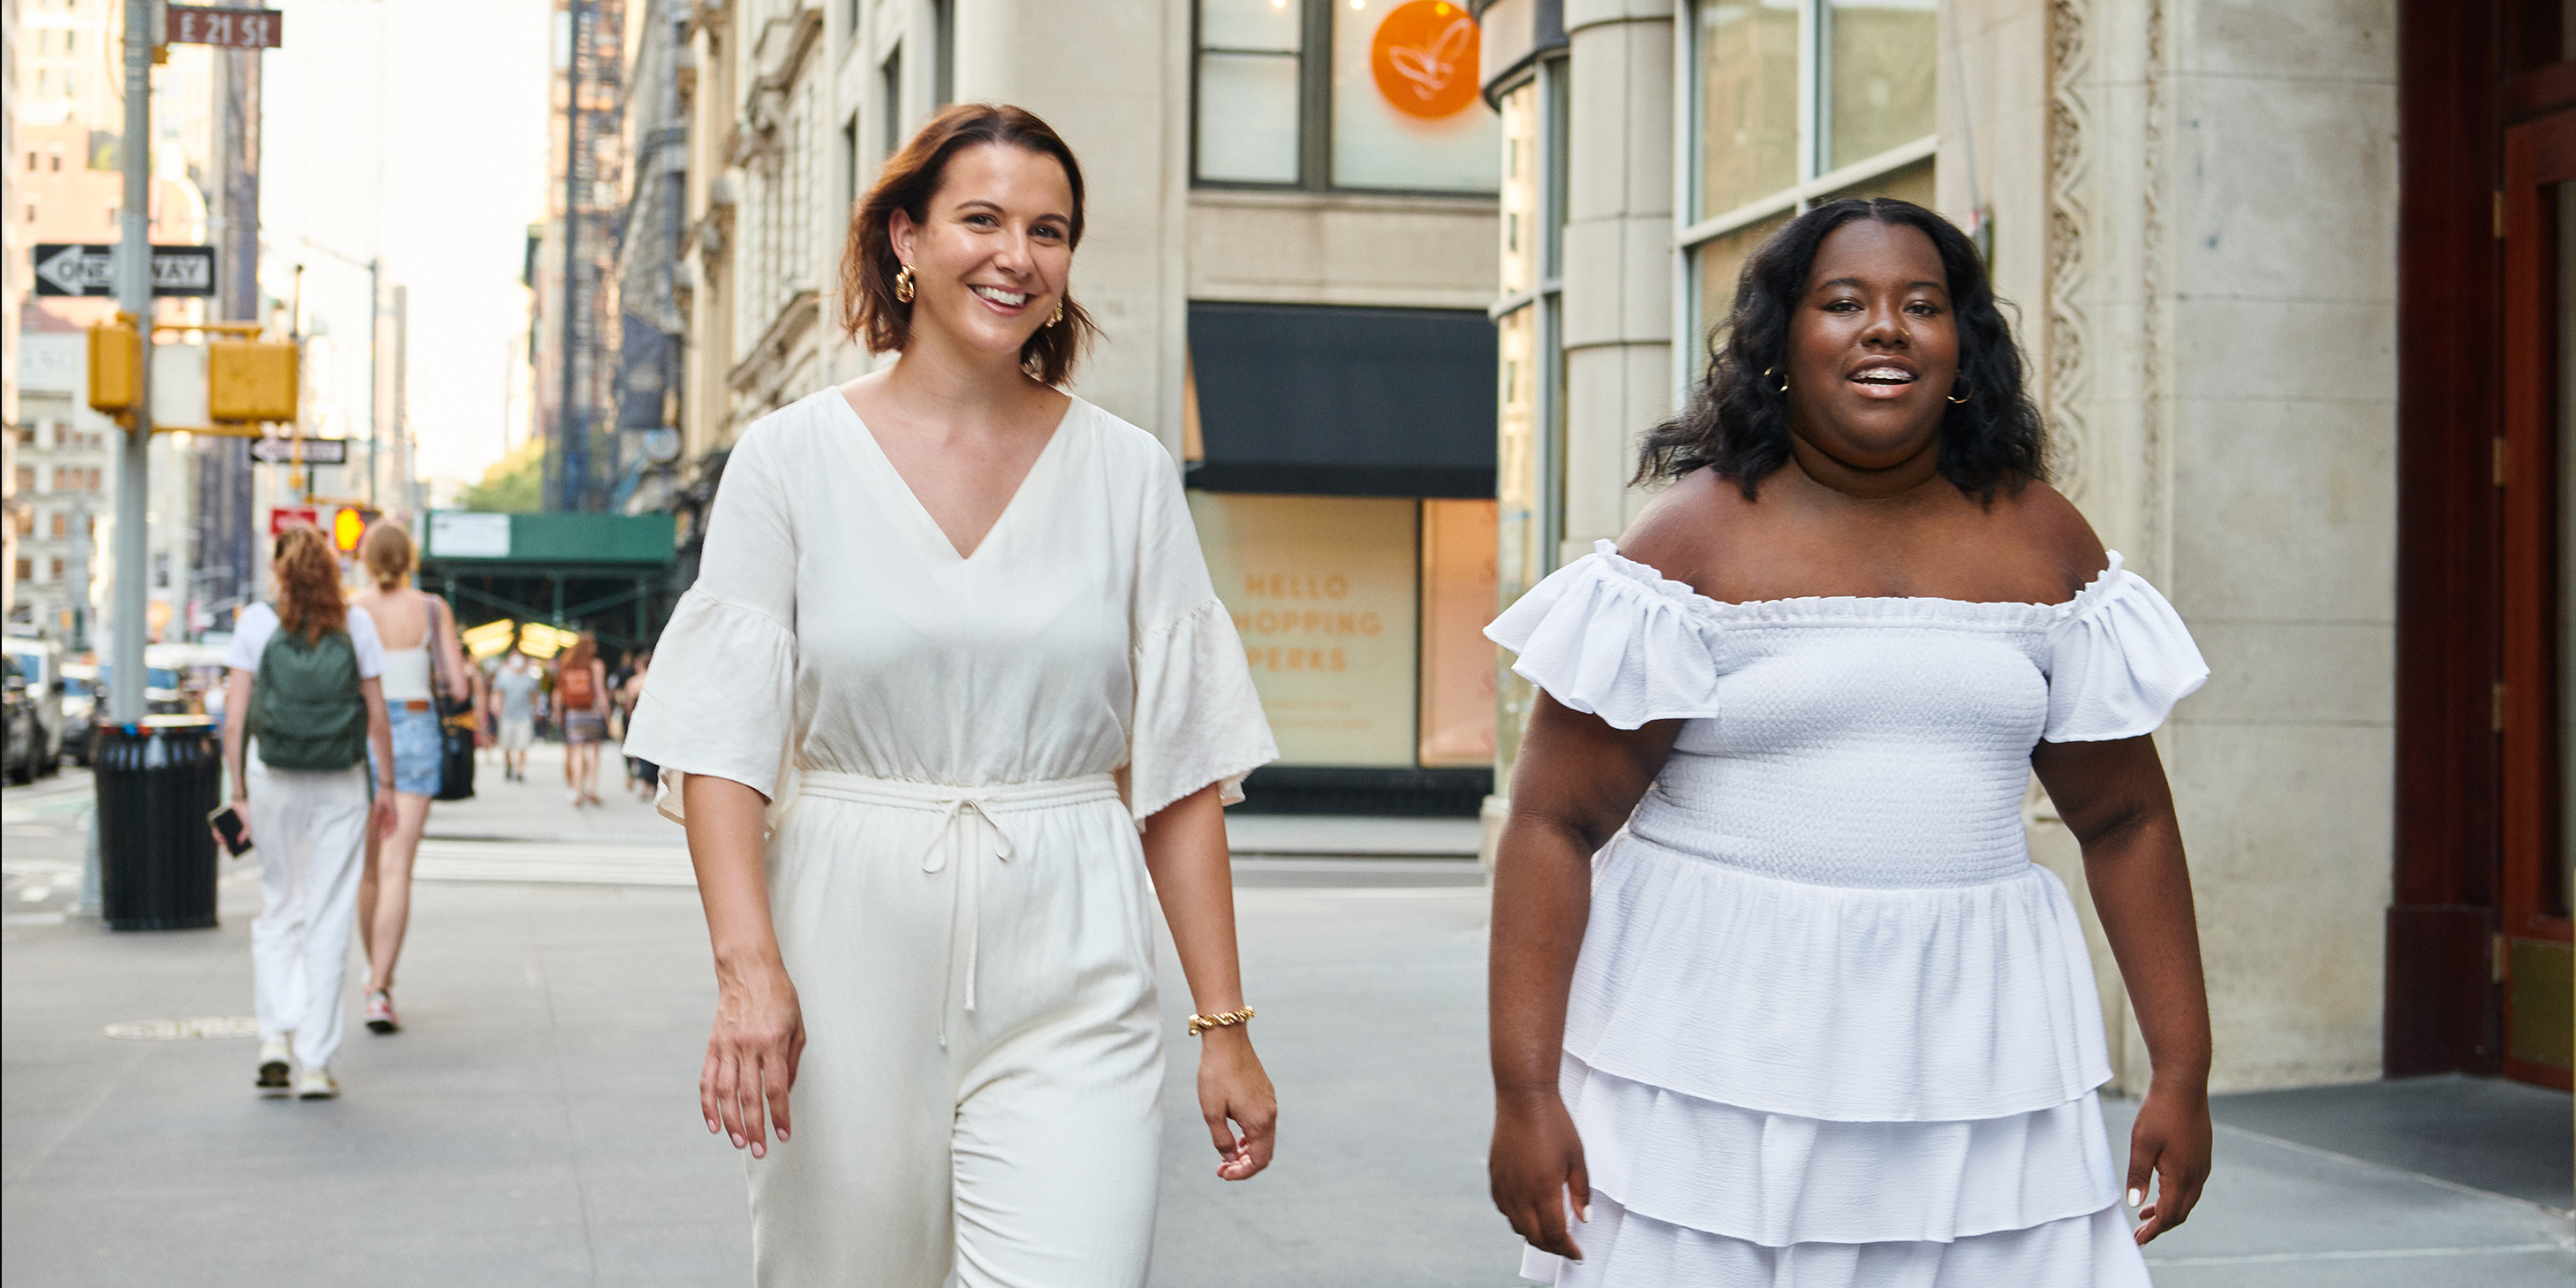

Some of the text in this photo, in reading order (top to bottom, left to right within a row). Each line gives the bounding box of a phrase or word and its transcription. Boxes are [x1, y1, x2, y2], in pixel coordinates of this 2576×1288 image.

[180, 11, 195, 42] E
[205, 13, 231, 45] 21
[57, 259, 107, 282] ONE
[1244, 573, 1350, 601] HELLO
[1232, 610, 1383, 638] HOPPING
[1246, 646, 1348, 673] PERKS
